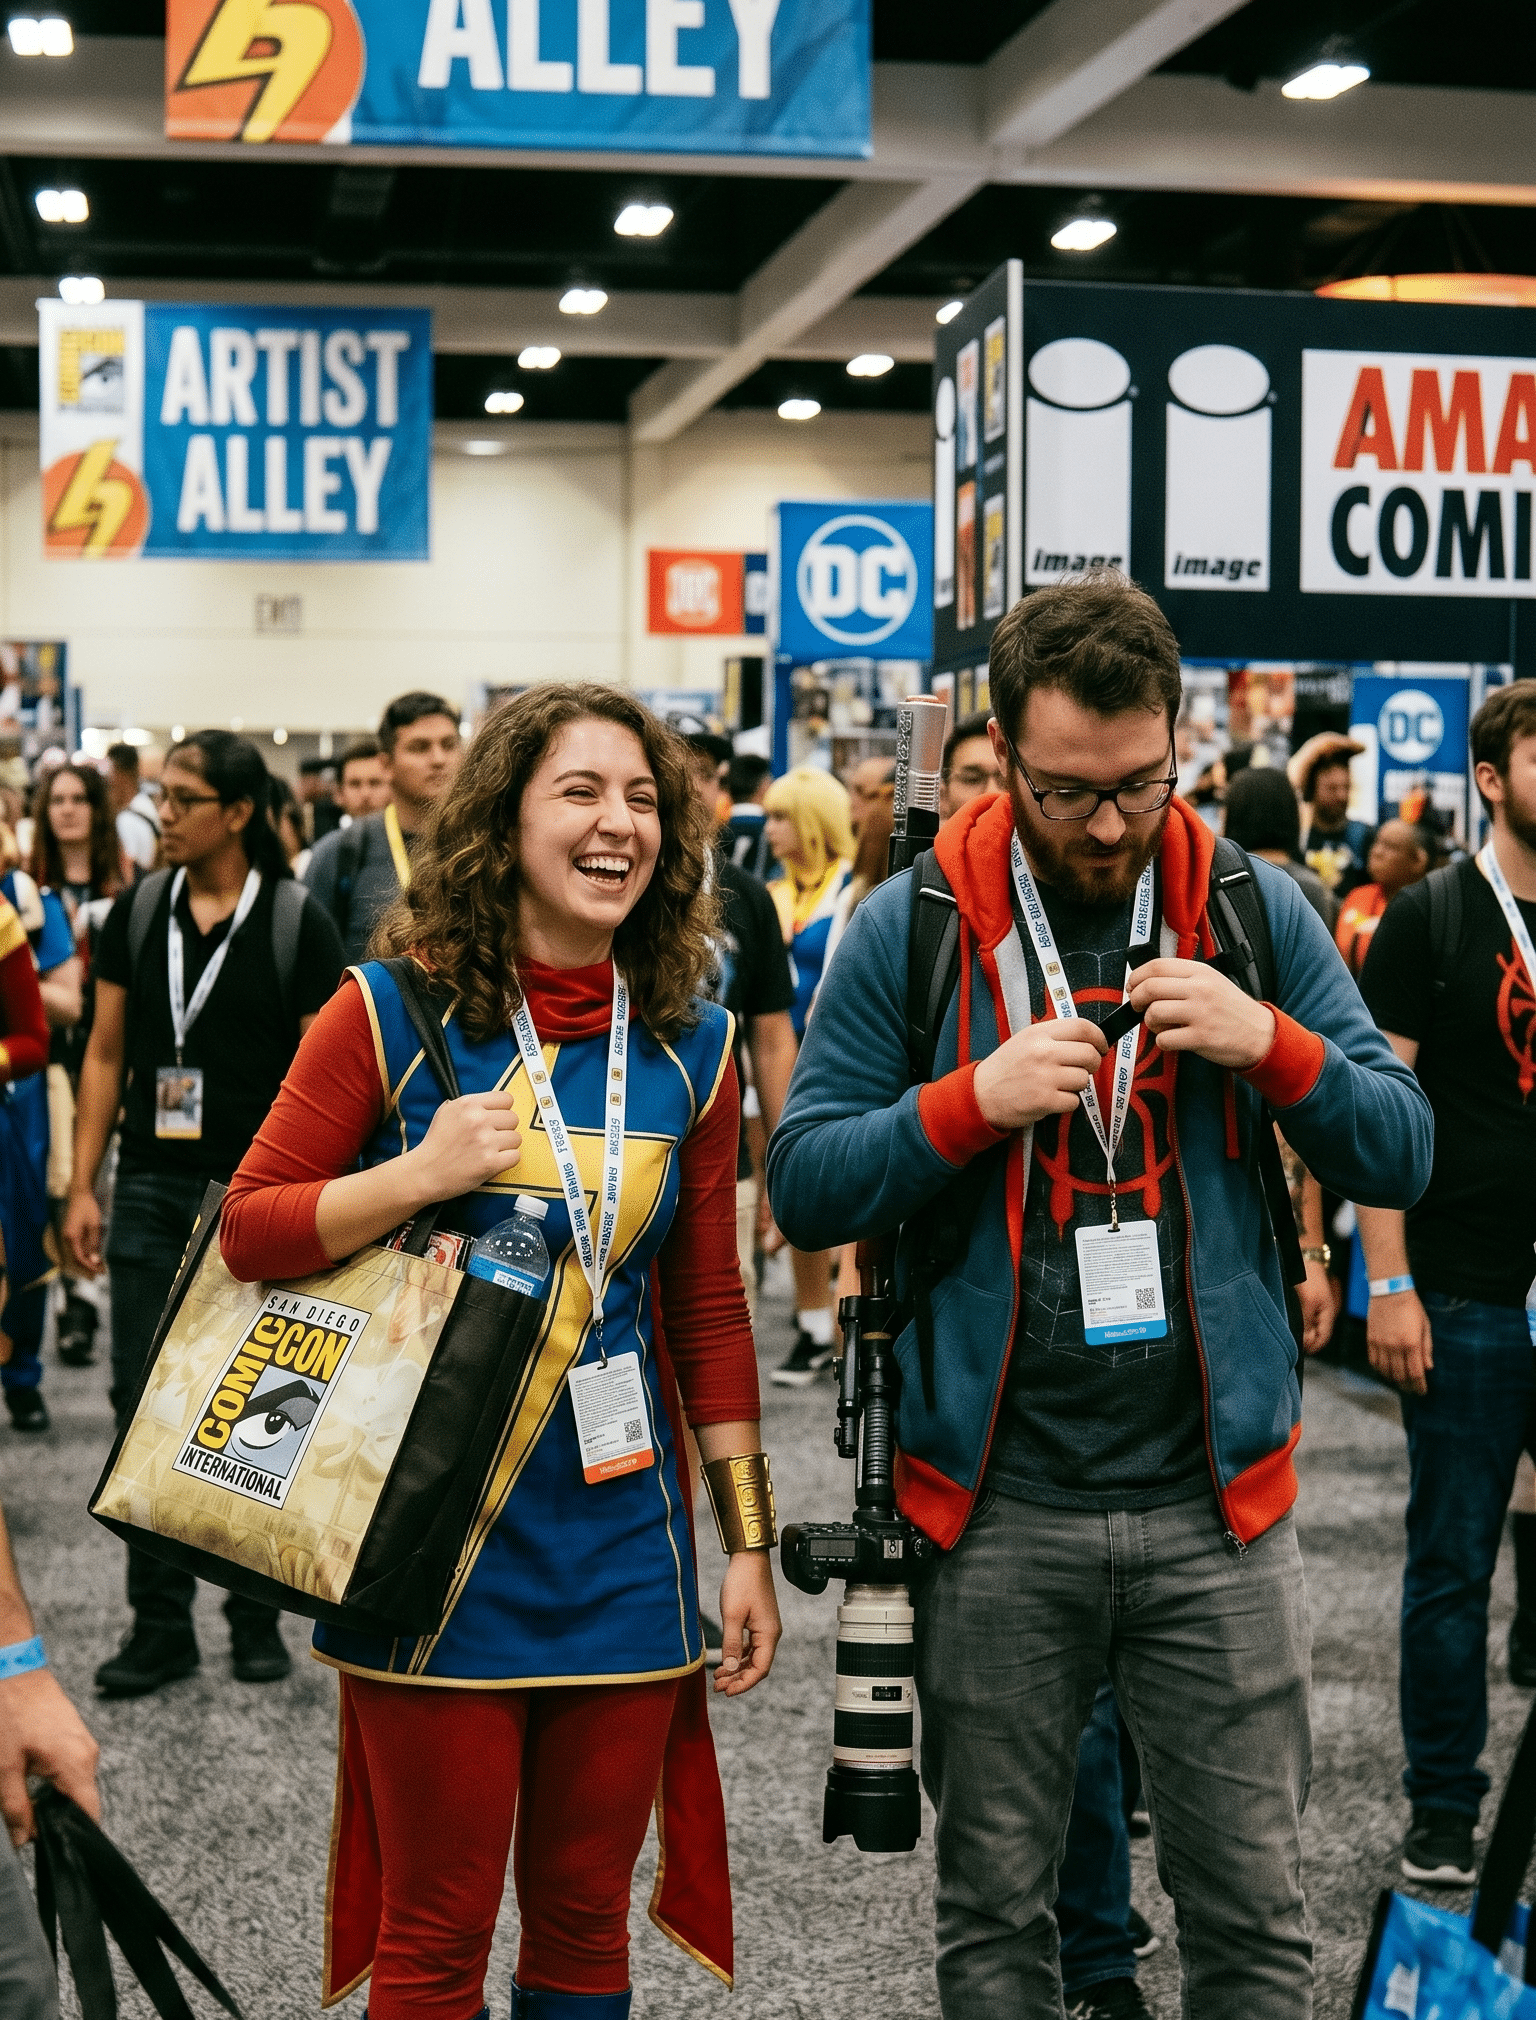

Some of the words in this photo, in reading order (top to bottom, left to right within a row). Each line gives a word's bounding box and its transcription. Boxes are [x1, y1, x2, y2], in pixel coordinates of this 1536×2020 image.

[418, 0, 780, 98] ALLEY
[161, 326, 410, 428] ARTIST
[1332, 366, 1536, 476] AMA
[177, 434, 393, 535] ALLEY
[1173, 552, 1262, 581] image
[1331, 485, 1532, 580] COMI
[803, 544, 910, 618] DC
[267, 1295, 301, 1315] SAN
[306, 1305, 360, 1332] DIEGO
[274, 1322, 351, 1382] CON
[197, 1316, 287, 1449] COMIC
[180, 1445, 282, 1501] INTERNATIONAL
